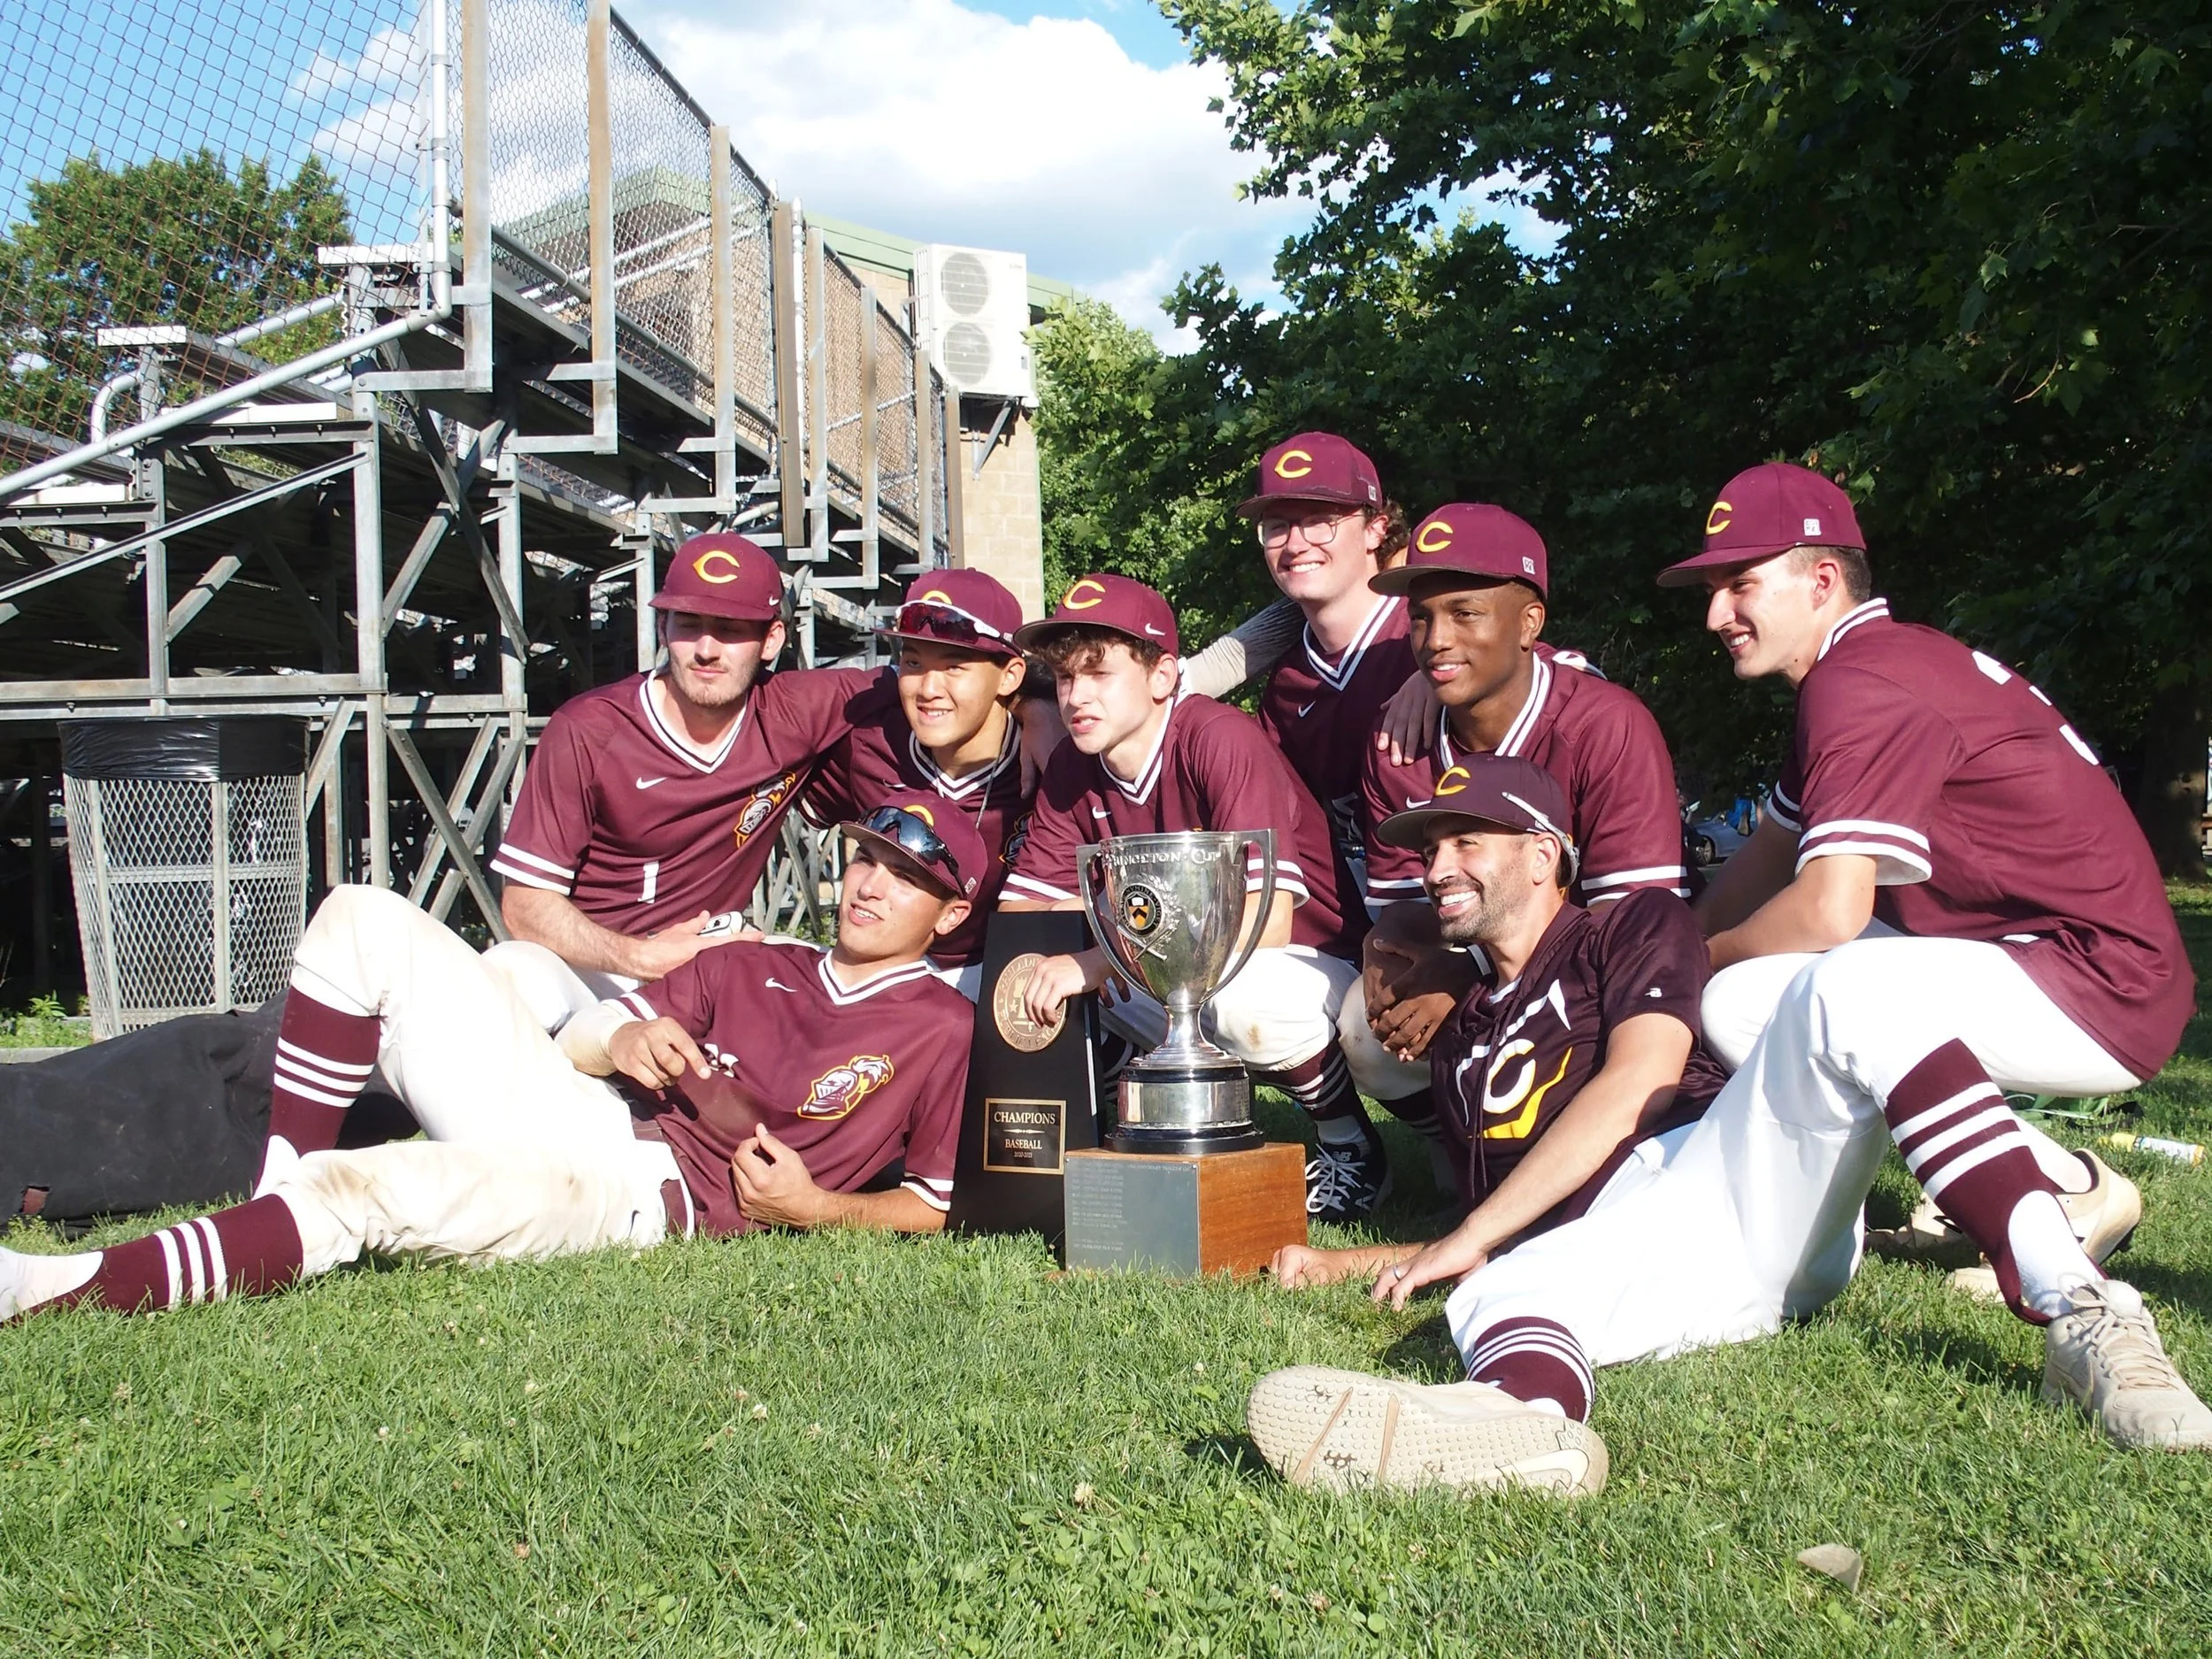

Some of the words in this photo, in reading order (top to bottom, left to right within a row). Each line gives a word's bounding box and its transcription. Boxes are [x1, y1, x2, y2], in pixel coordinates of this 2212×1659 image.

[1274, 450, 1312, 479] C
[1706, 502, 1732, 534] C
[1417, 521, 1453, 553] C
[693, 549, 740, 583] C
[1062, 579, 1106, 610] C
[1435, 766, 1471, 795] C
[638, 860, 659, 903] 1
[1483, 1039, 1536, 1114] C
[994, 1111, 1056, 1125] CHAMPIONS
[1005, 1139, 1042, 1149] BASEBALL
